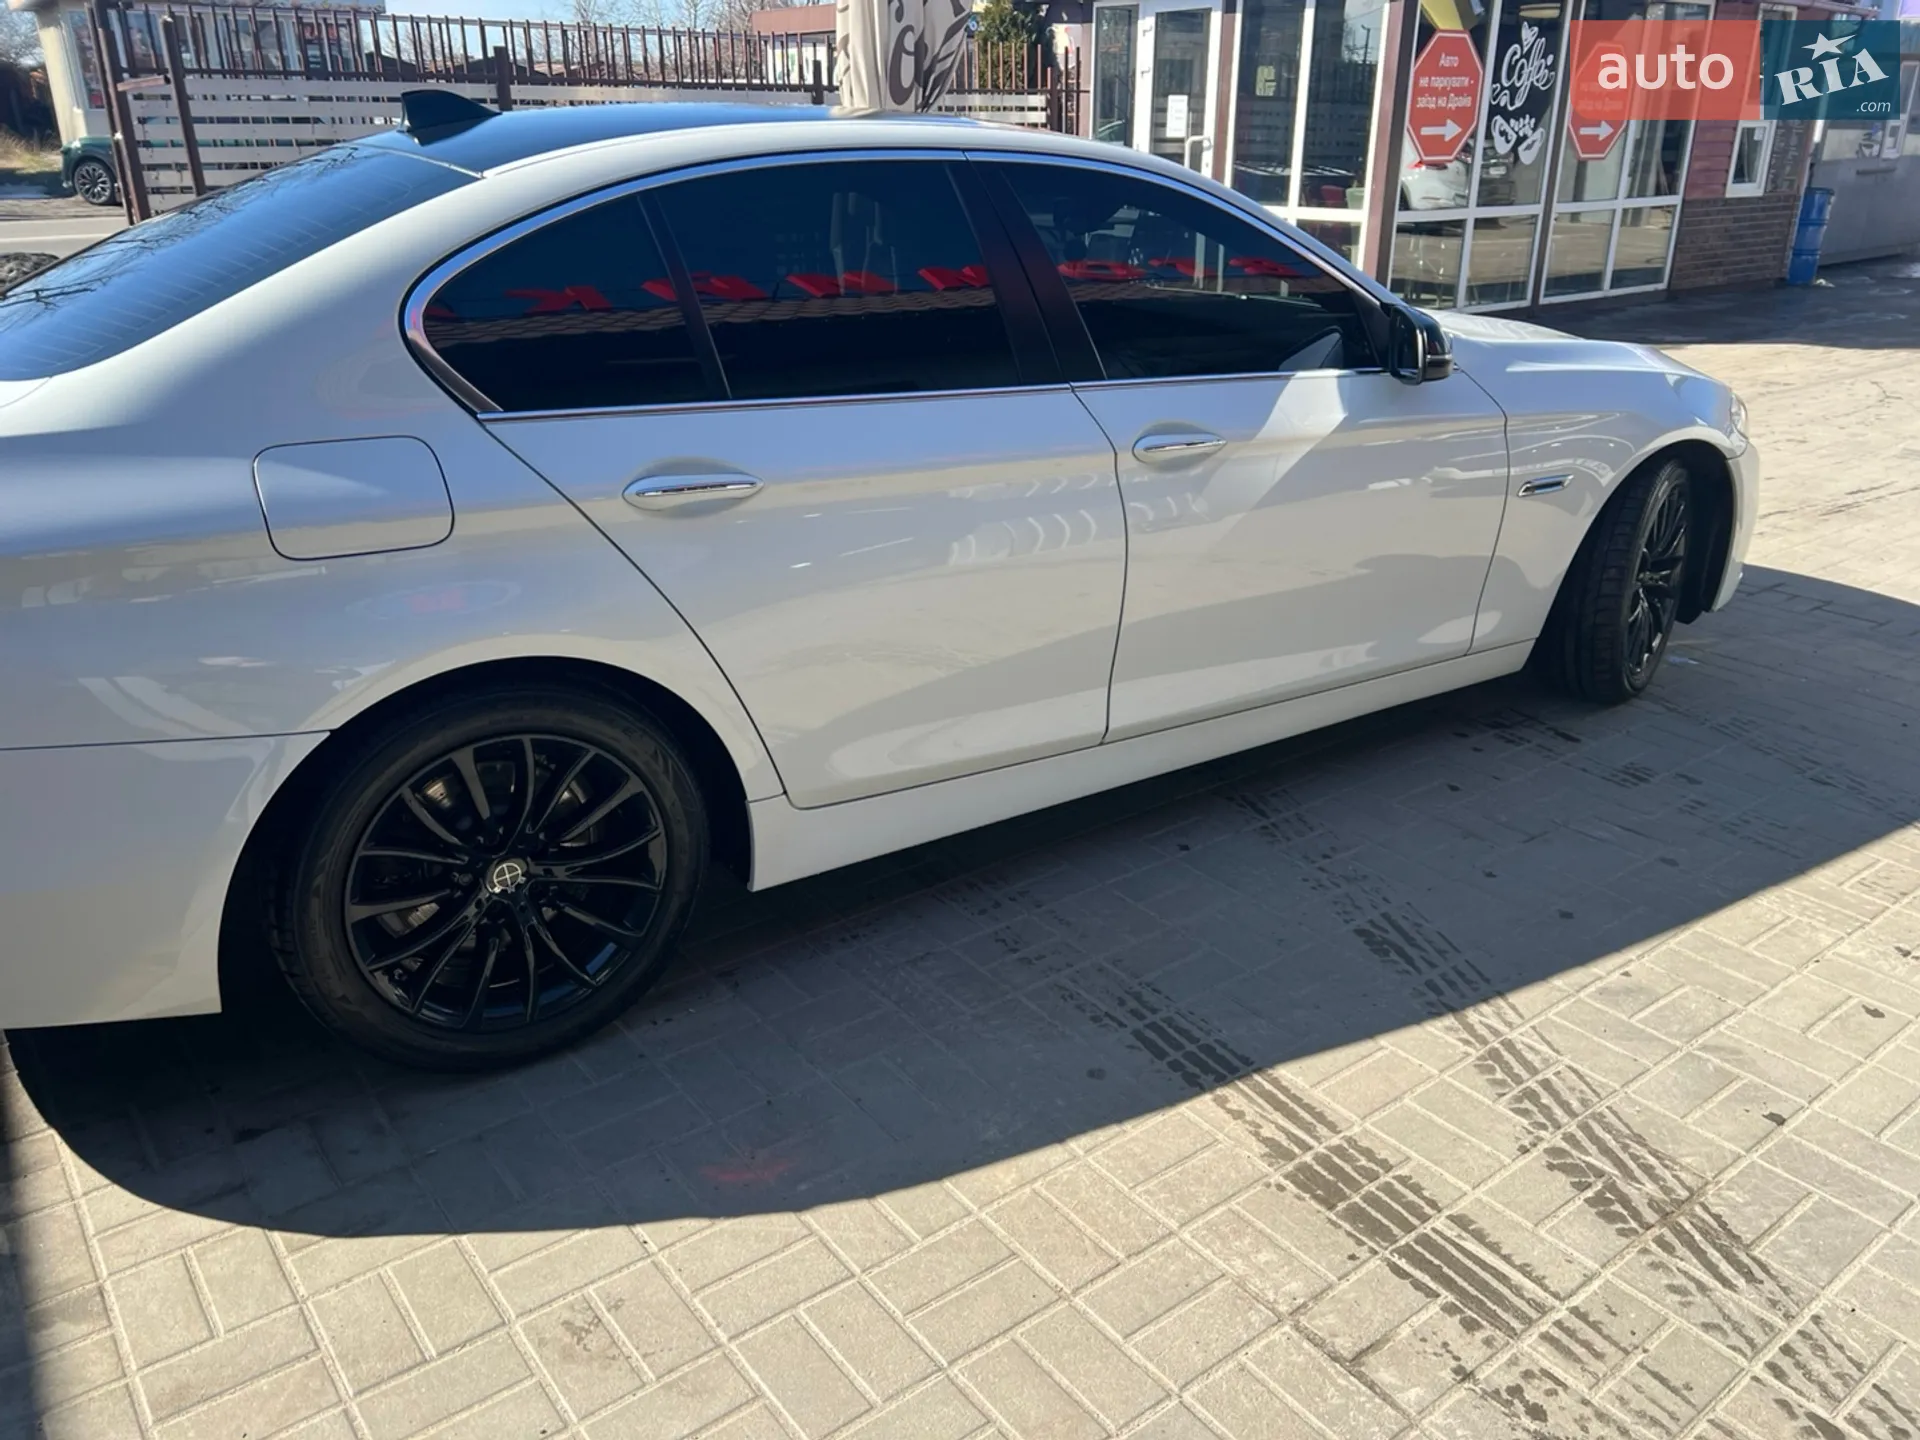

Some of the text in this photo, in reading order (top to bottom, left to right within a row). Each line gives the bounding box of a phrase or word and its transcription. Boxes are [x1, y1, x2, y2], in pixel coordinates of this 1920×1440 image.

[1439, 52, 1459, 67] Авто
[1419, 76, 1429, 87] не
[1437, 96, 1447, 108] на
